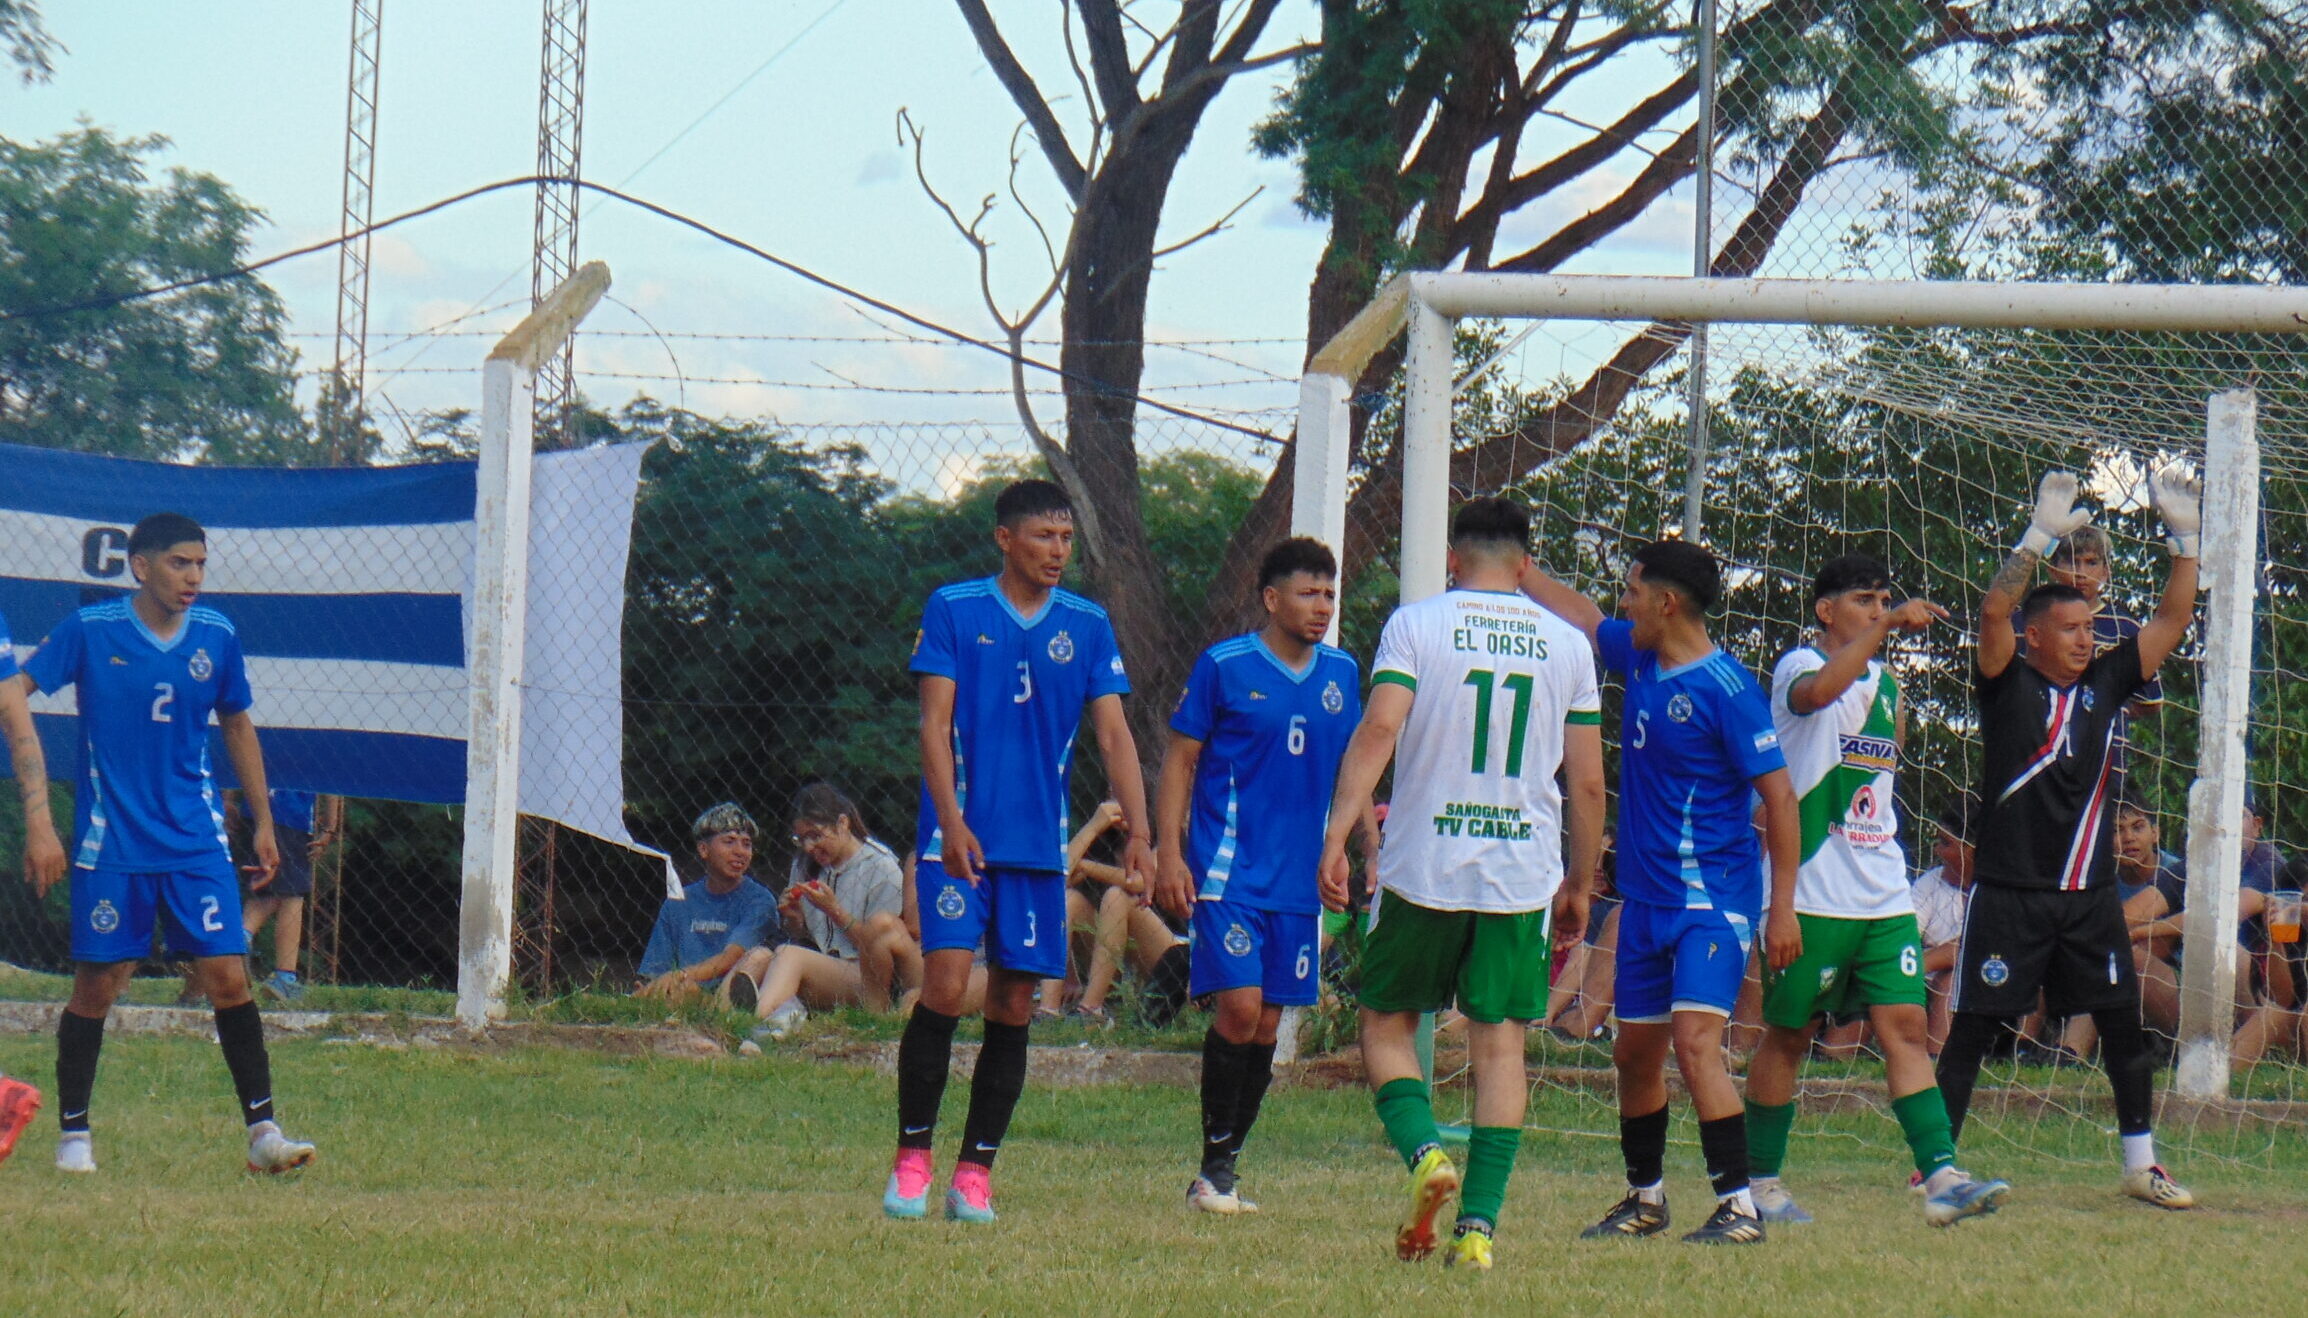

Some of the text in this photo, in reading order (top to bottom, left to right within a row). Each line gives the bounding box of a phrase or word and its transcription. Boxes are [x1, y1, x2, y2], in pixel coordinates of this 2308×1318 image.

[1456, 601, 1484, 611] CAMINO
[1492, 603, 1505, 614] LOS
[1507, 606, 1520, 615] 100
[1464, 615, 1537, 636] FERRETERÍA
[1454, 628, 1548, 661] EL OASIS
[1014, 660, 1031, 703] 3
[152, 682, 173, 723] 2
[1287, 714, 1307, 755] 6
[1463, 668, 1535, 779] 11
[1633, 709, 1650, 749] 5
[1433, 816, 1532, 841] TV CABLE
[201, 895, 224, 932] 2
[1023, 910, 1036, 947] 3
[1295, 943, 1311, 980] 6
[1900, 945, 1917, 977] 6
